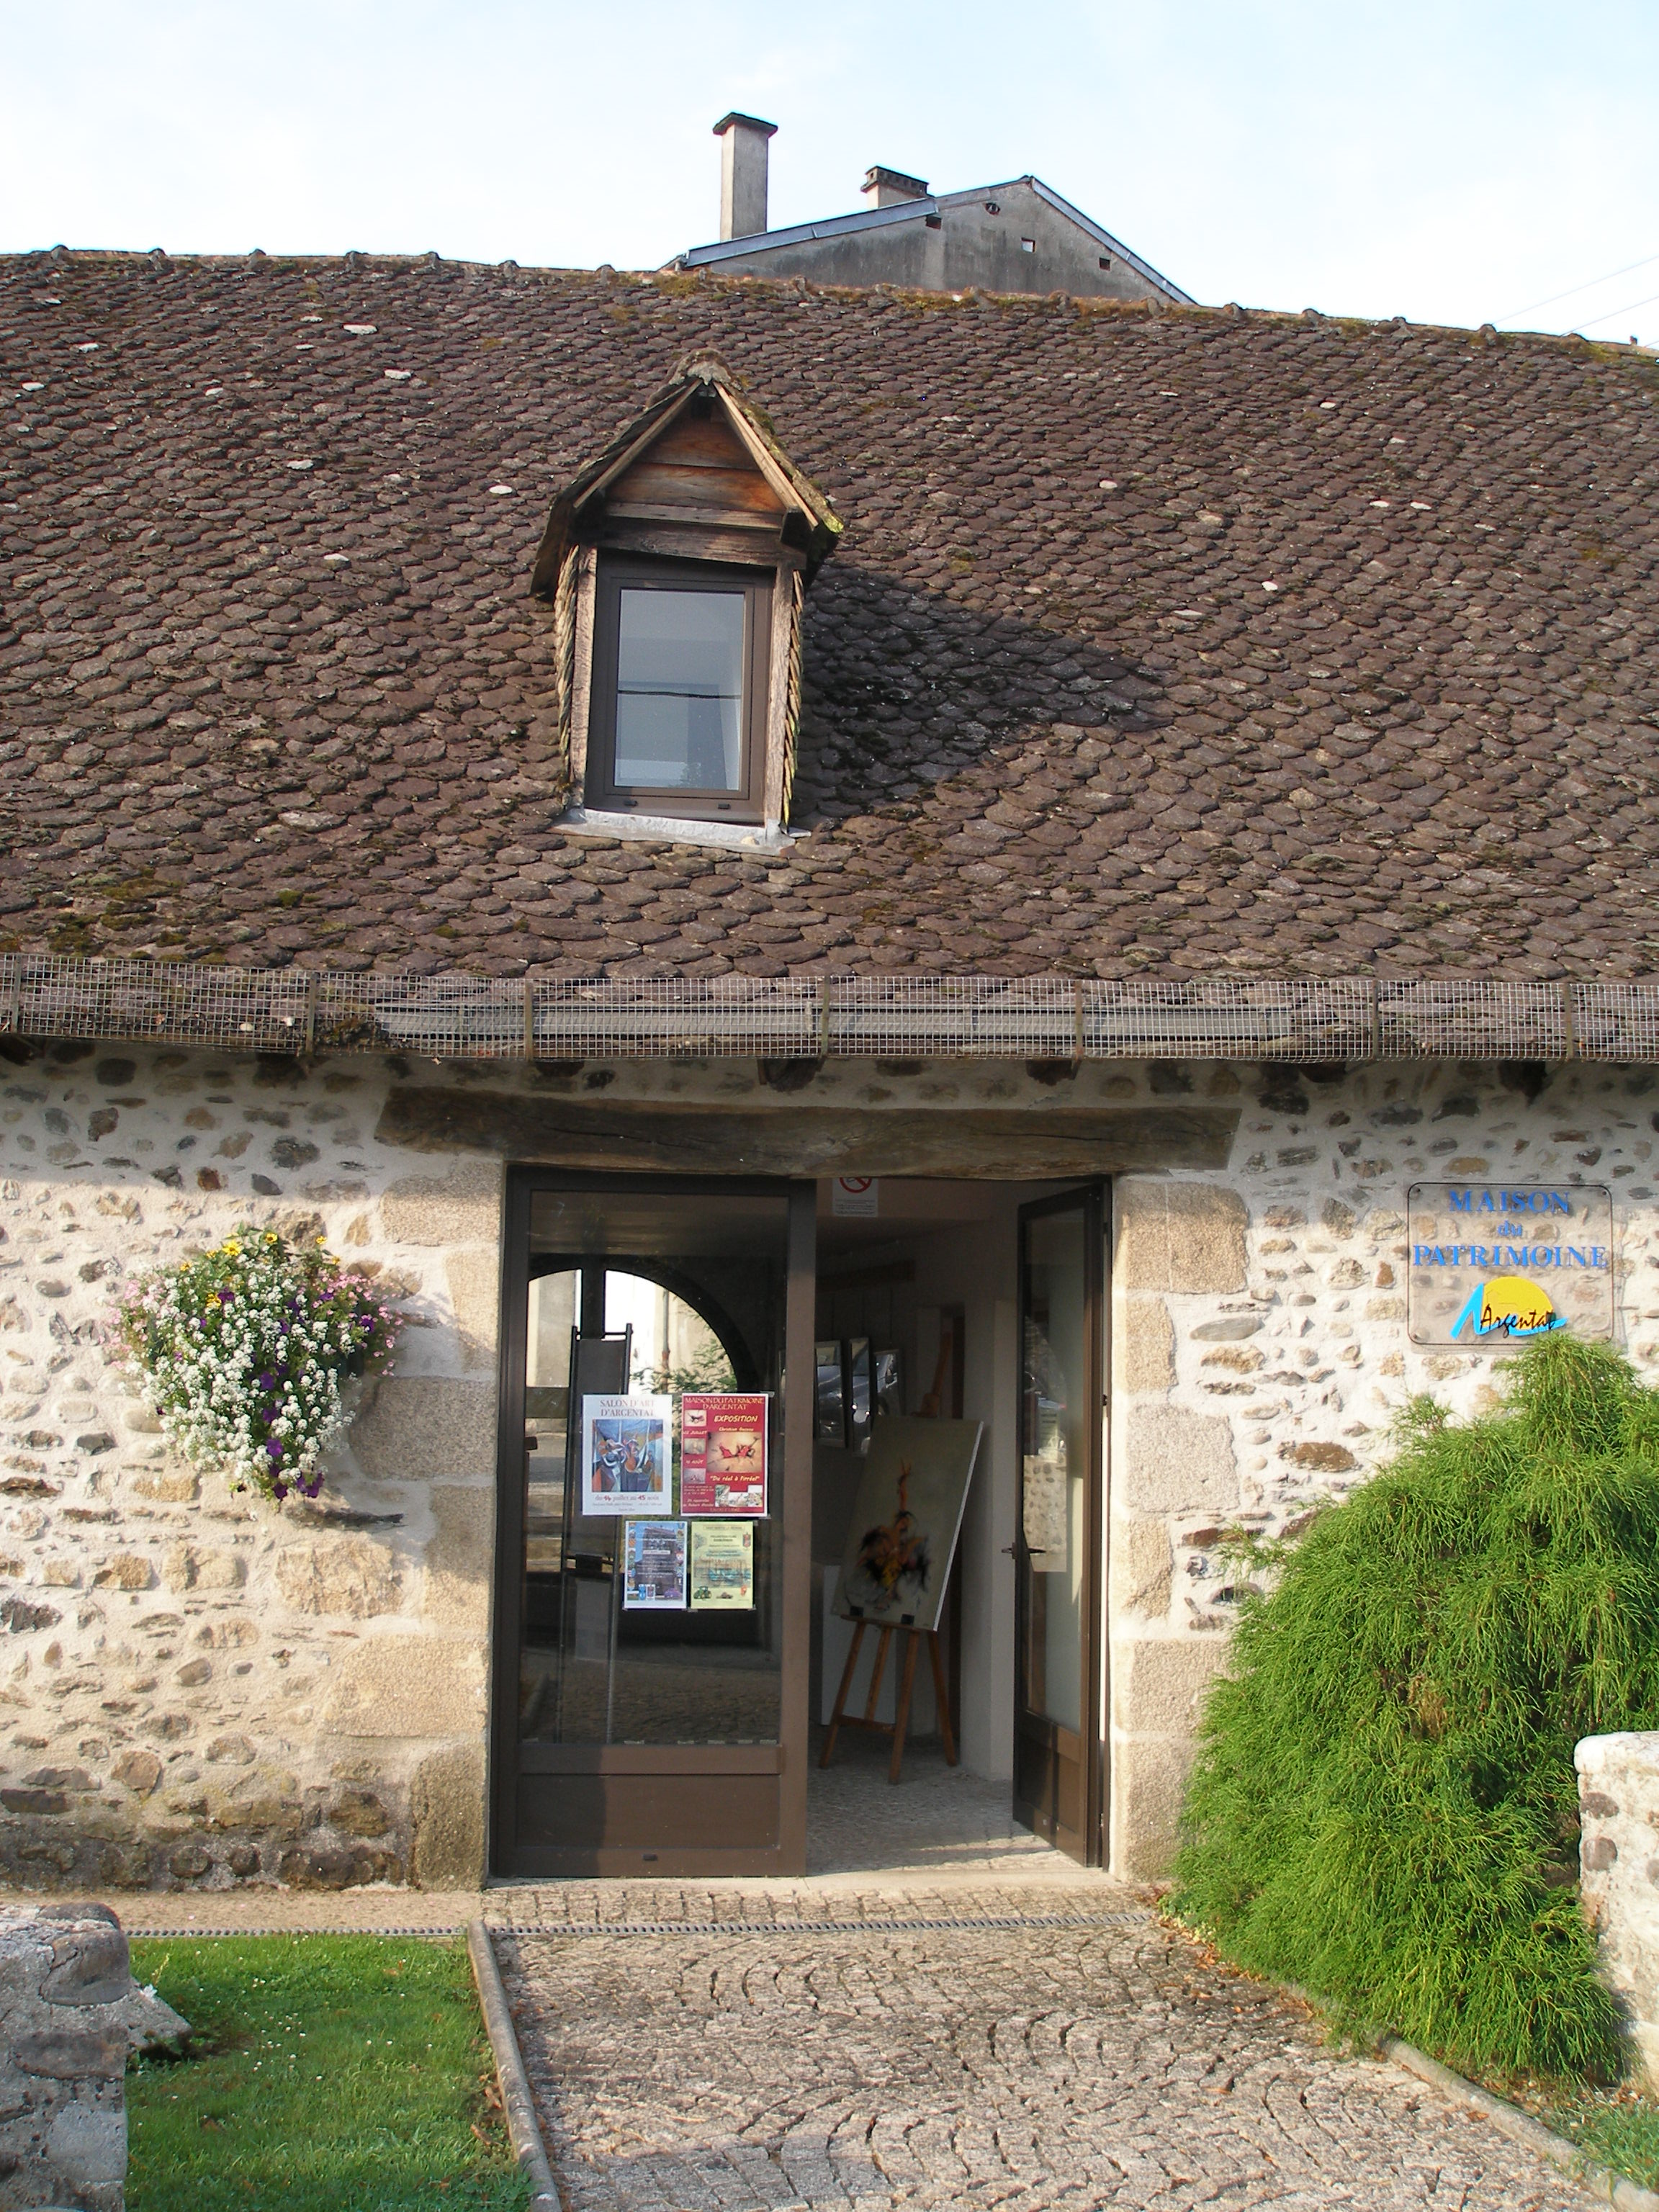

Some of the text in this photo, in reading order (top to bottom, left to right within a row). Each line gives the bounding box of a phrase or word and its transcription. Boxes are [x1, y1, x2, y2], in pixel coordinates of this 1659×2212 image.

[1448, 1189, 1570, 1214] MAISON
[1497, 1220, 1523, 1237] du
[1412, 1245, 1607, 1268] PATRIMOINE
[1480, 1303, 1556, 1339] Argentat
